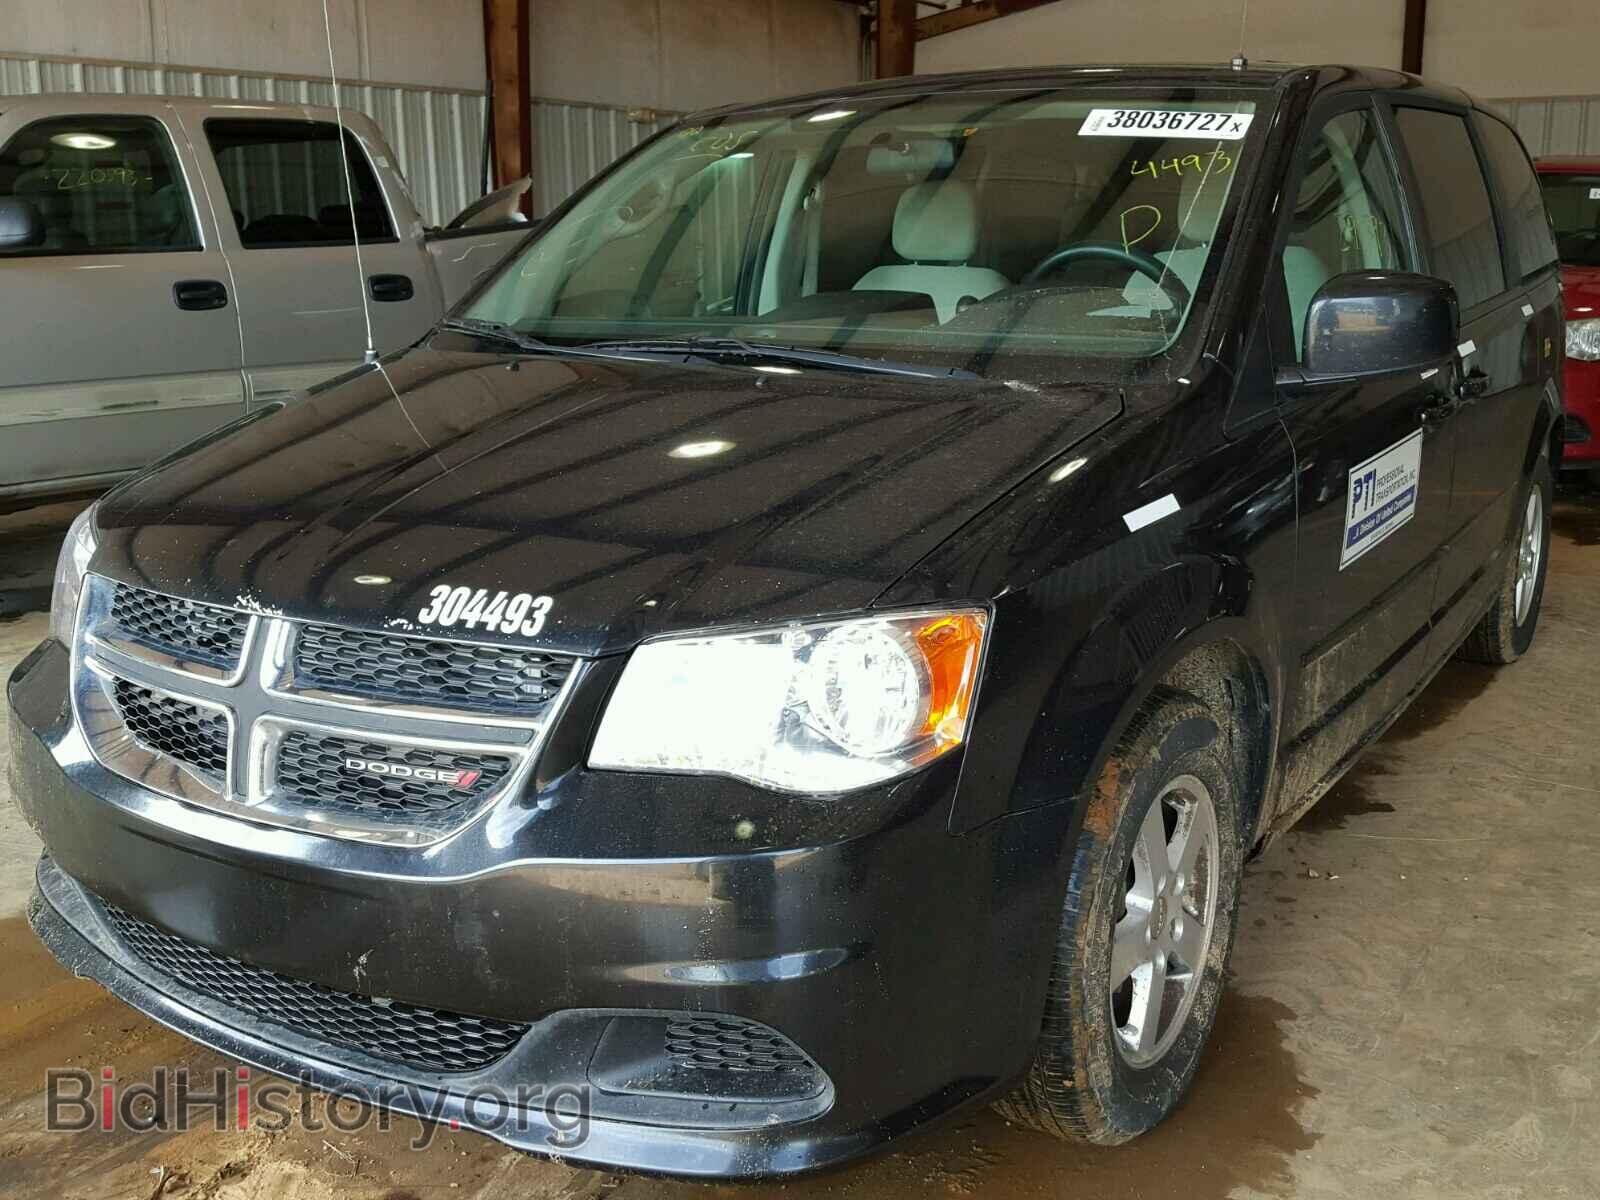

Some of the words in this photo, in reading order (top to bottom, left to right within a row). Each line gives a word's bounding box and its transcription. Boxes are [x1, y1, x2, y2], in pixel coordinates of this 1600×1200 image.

[1130, 150, 1232, 179] 4493
[1351, 467, 1376, 519] PTI
[418, 584, 554, 637] 304493
[345, 758, 460, 783] DODGE
